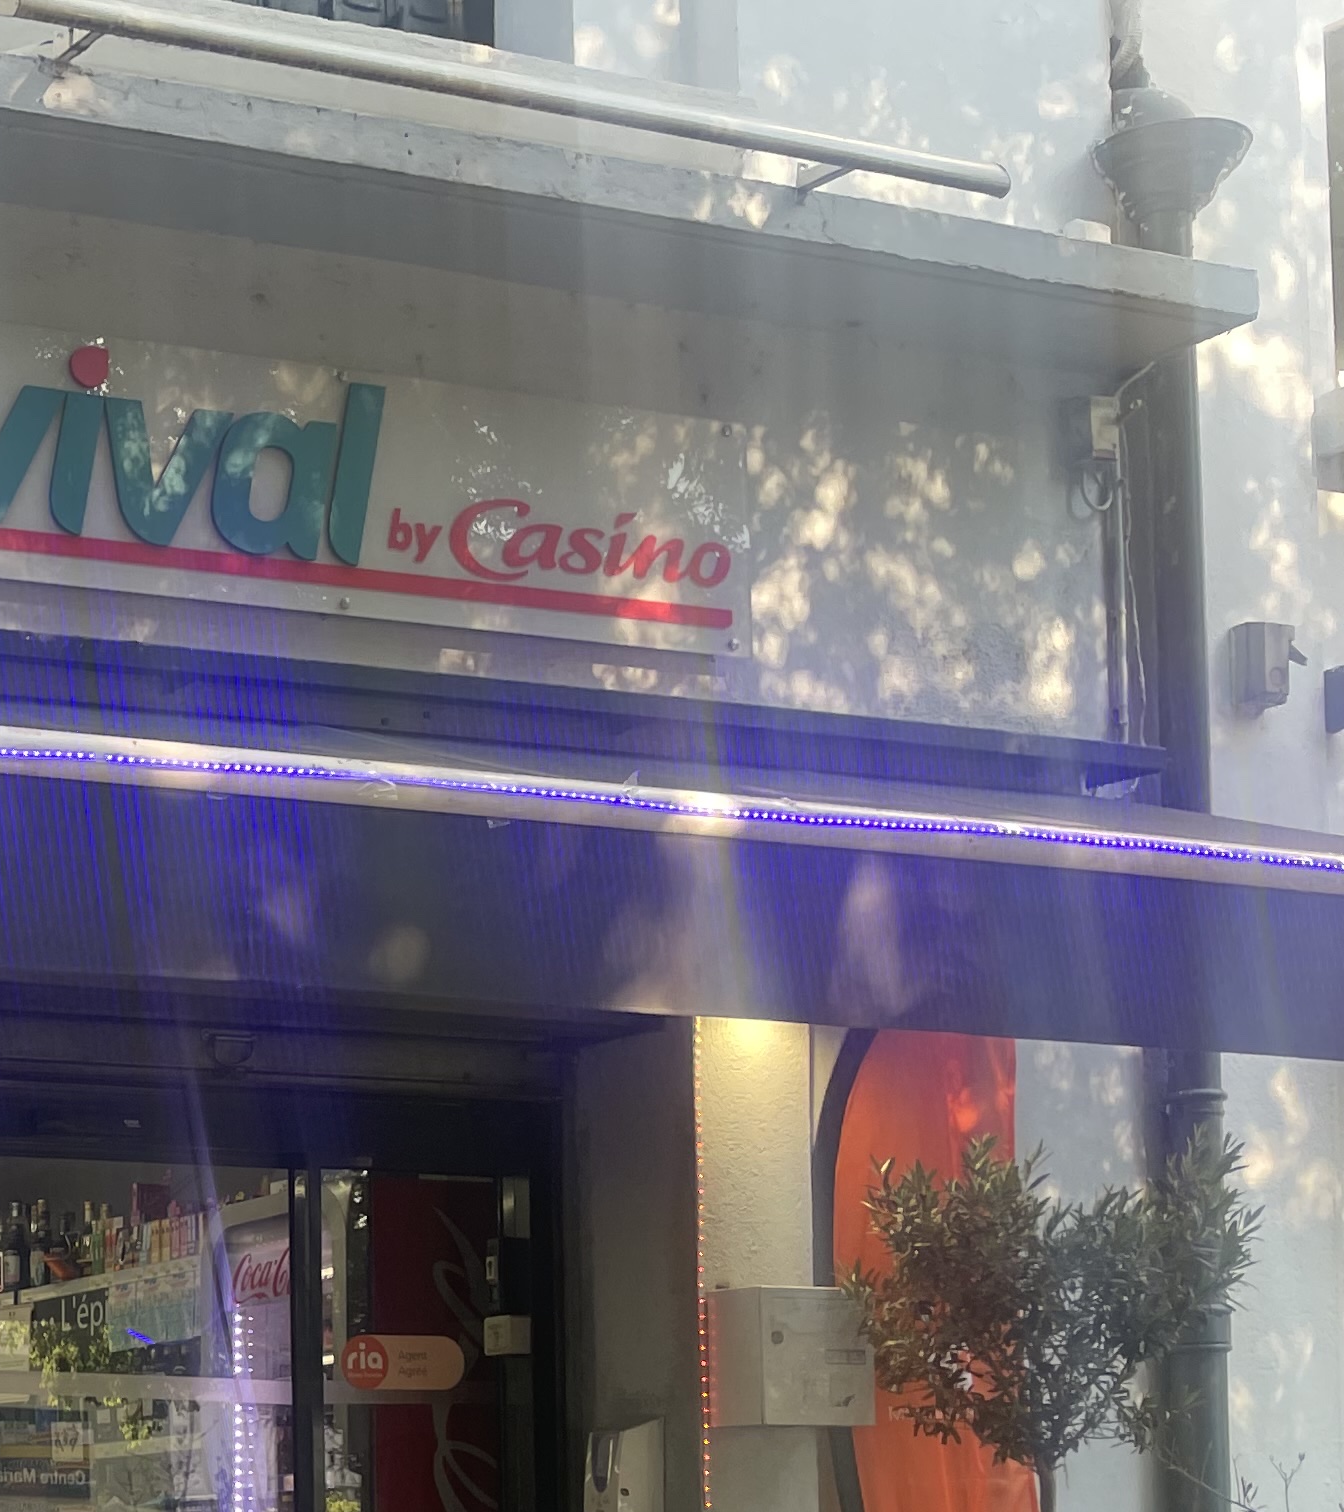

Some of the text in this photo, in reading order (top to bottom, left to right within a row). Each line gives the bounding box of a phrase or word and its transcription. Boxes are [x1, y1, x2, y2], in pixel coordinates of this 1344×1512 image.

[388, 499, 732, 589] by Casino
[347, 1342, 384, 1370] ria
[398, 1350, 428, 1363] Agent
